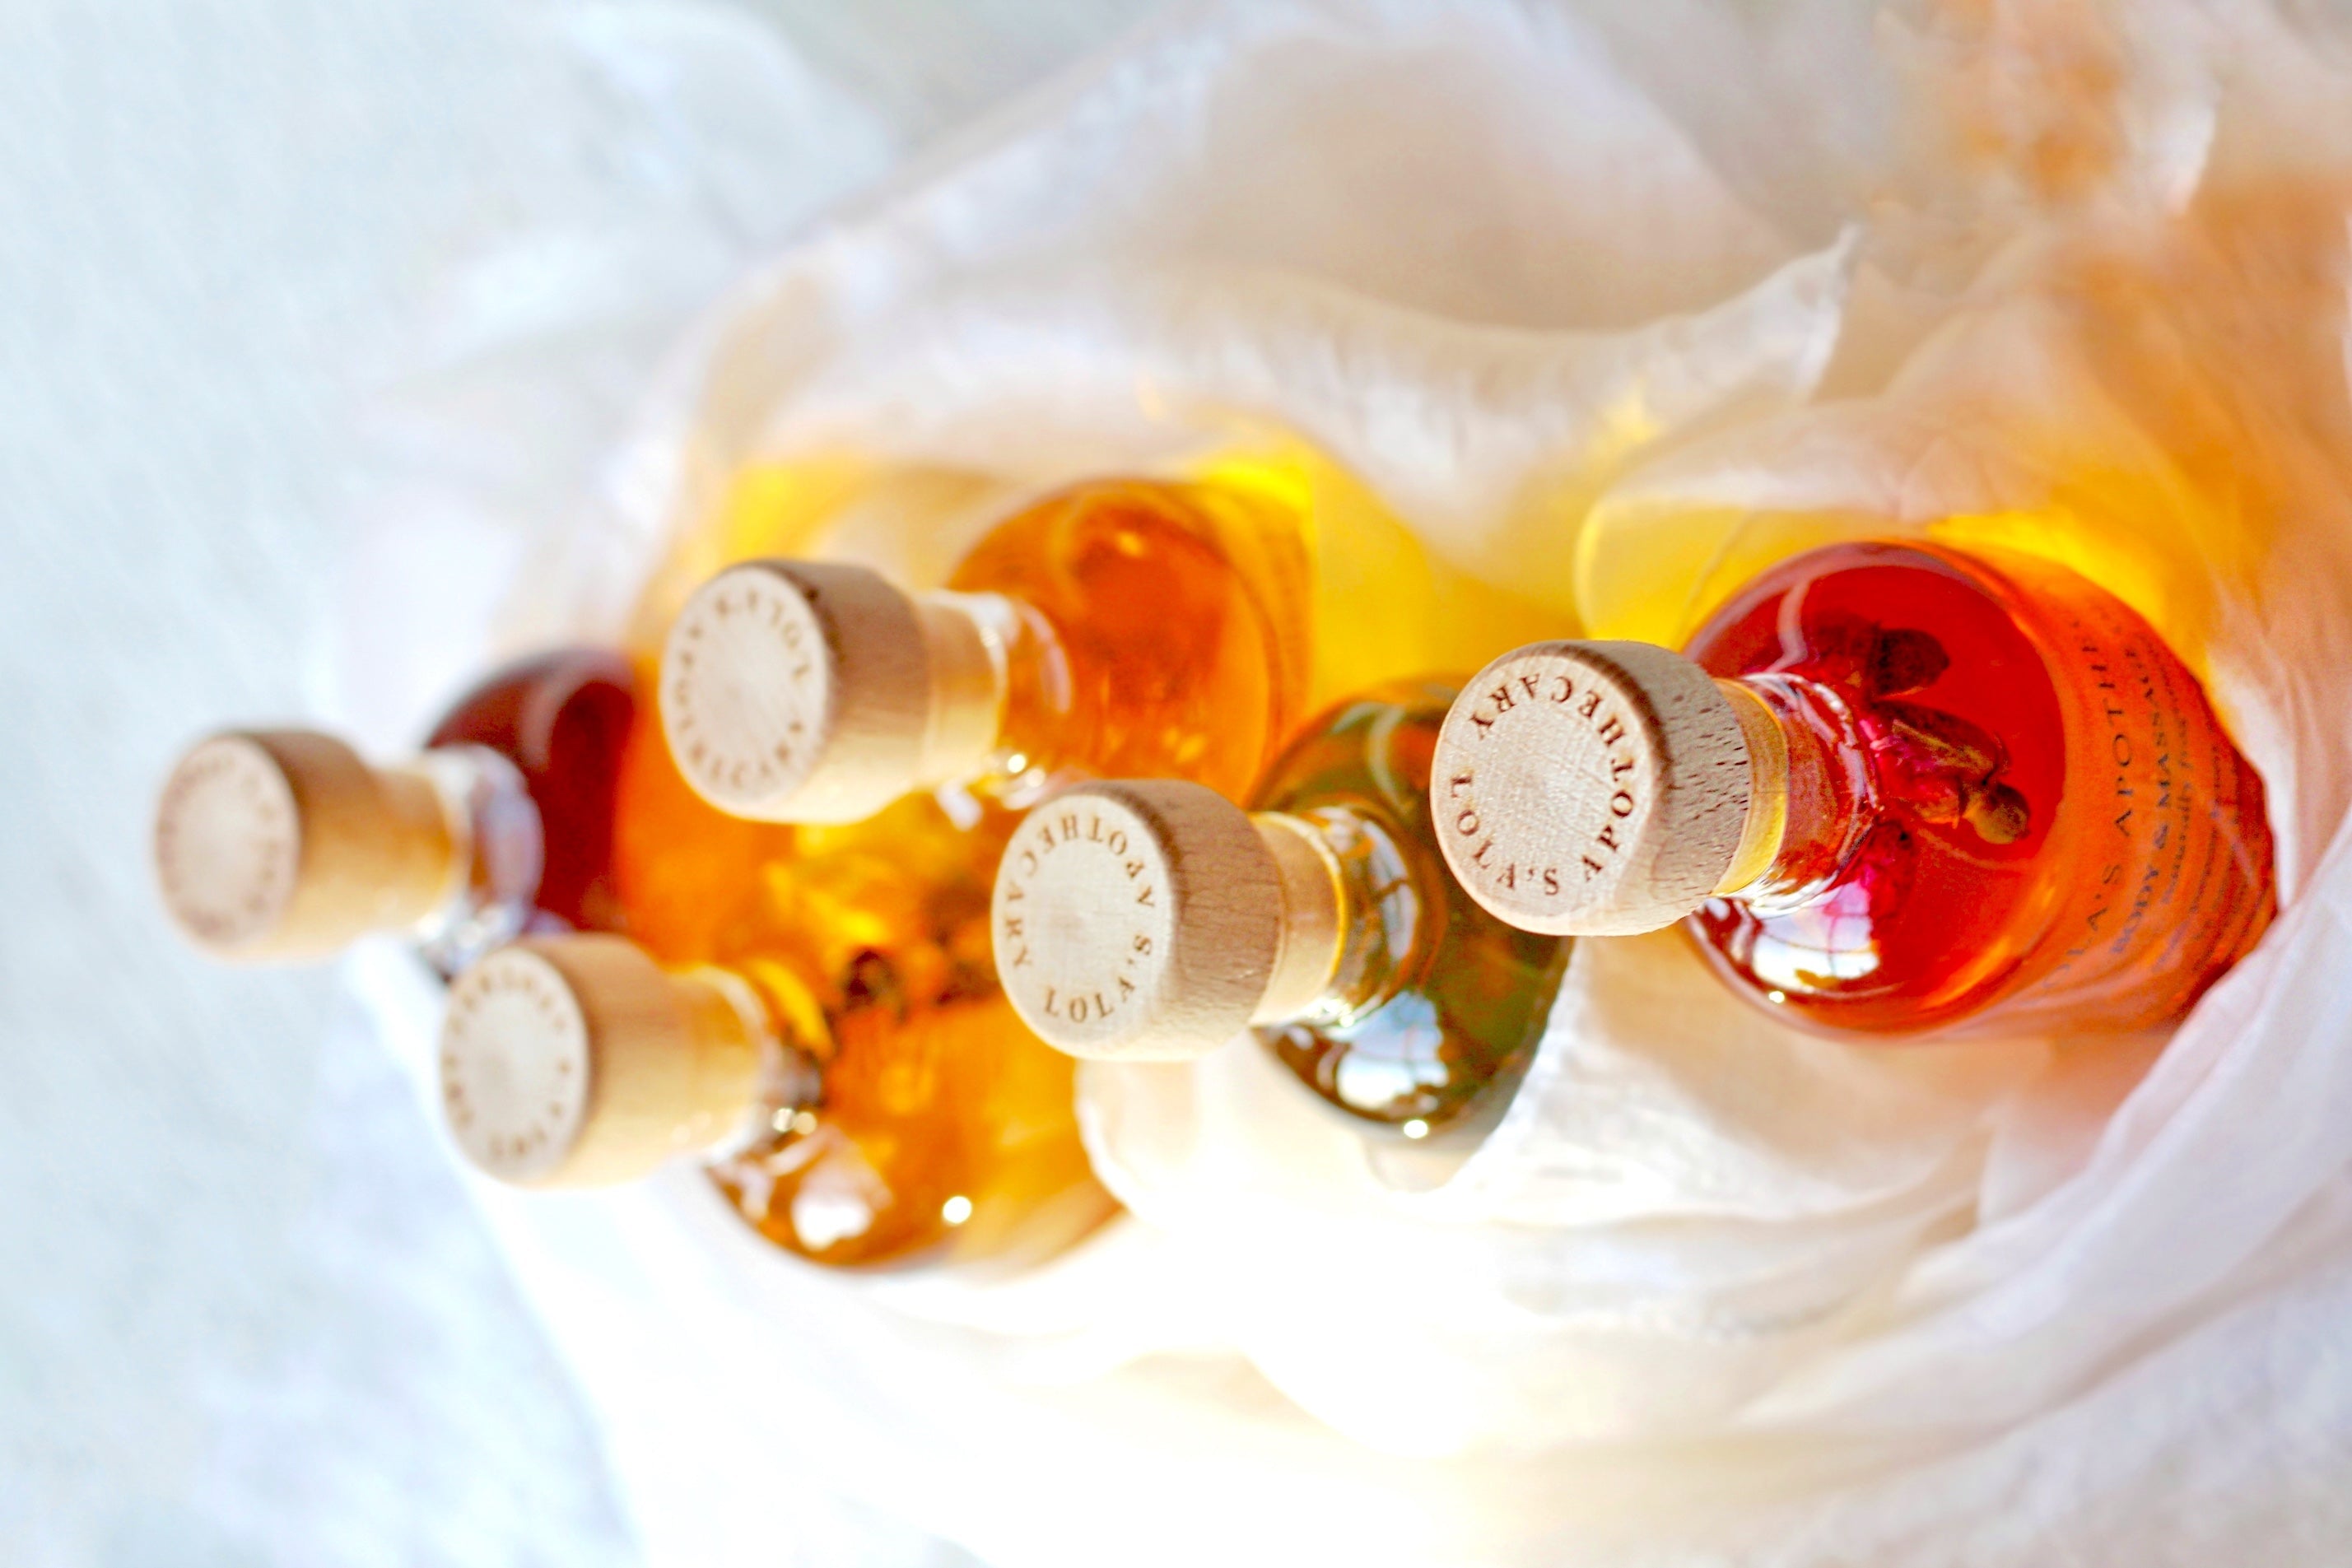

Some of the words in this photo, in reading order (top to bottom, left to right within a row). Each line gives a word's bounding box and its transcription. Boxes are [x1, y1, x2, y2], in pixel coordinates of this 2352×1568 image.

[1450, 770, 1560, 896] LOLA'S
[1469, 672, 1635, 882] APOTHECARY
[1004, 814, 1155, 970] APOTHECARY
[1043, 934, 1152, 1023] LOLA'S
